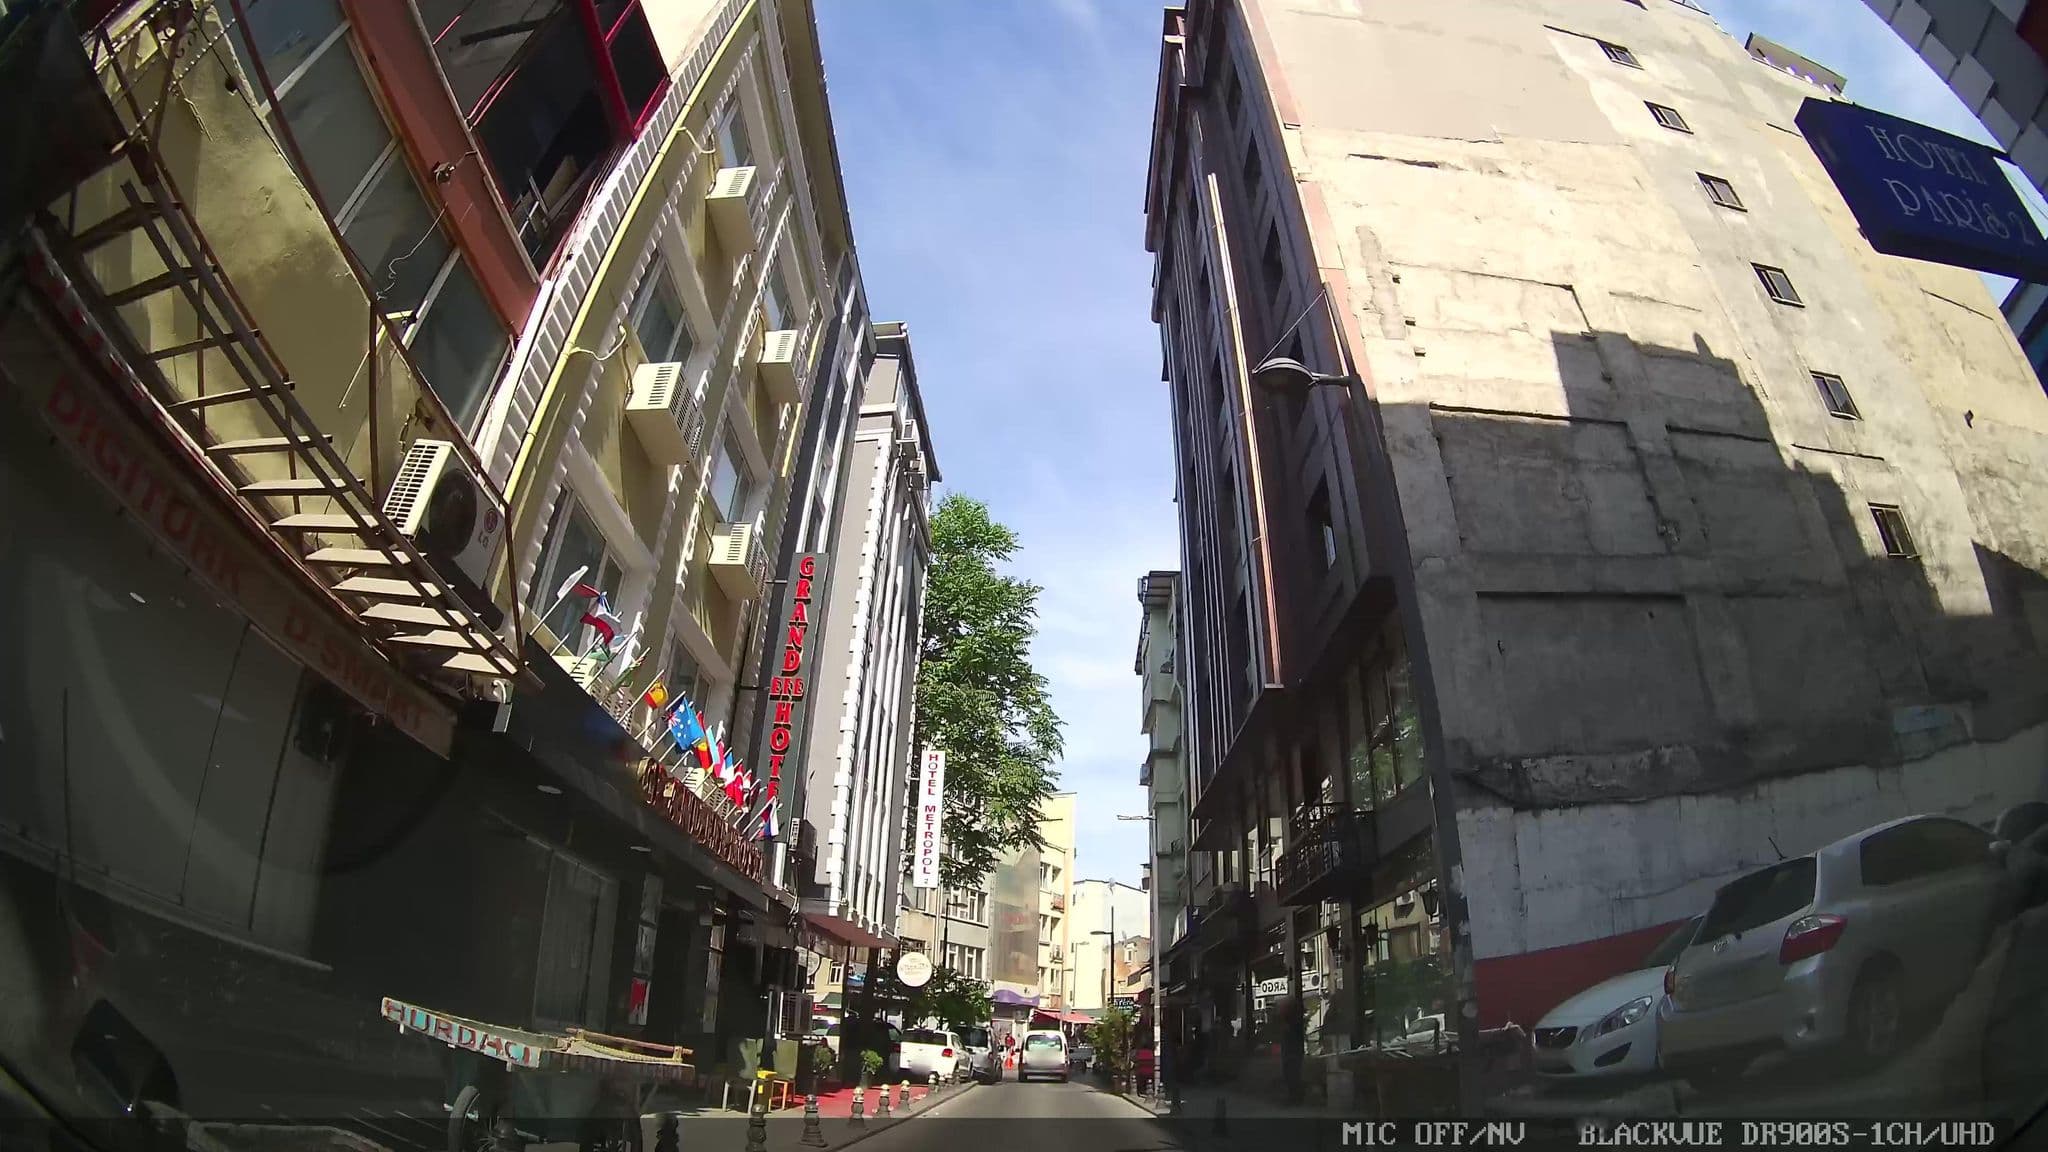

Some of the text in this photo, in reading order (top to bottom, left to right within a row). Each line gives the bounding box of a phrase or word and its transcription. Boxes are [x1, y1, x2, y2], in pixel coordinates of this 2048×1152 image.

[1865, 124, 1988, 186] HOTEL
[764, 555, 816, 808] GRAND EFE HOTE
[922, 753, 940, 875] HOTEL METROPOL
[387, 1000, 530, 1064] HURDACI
